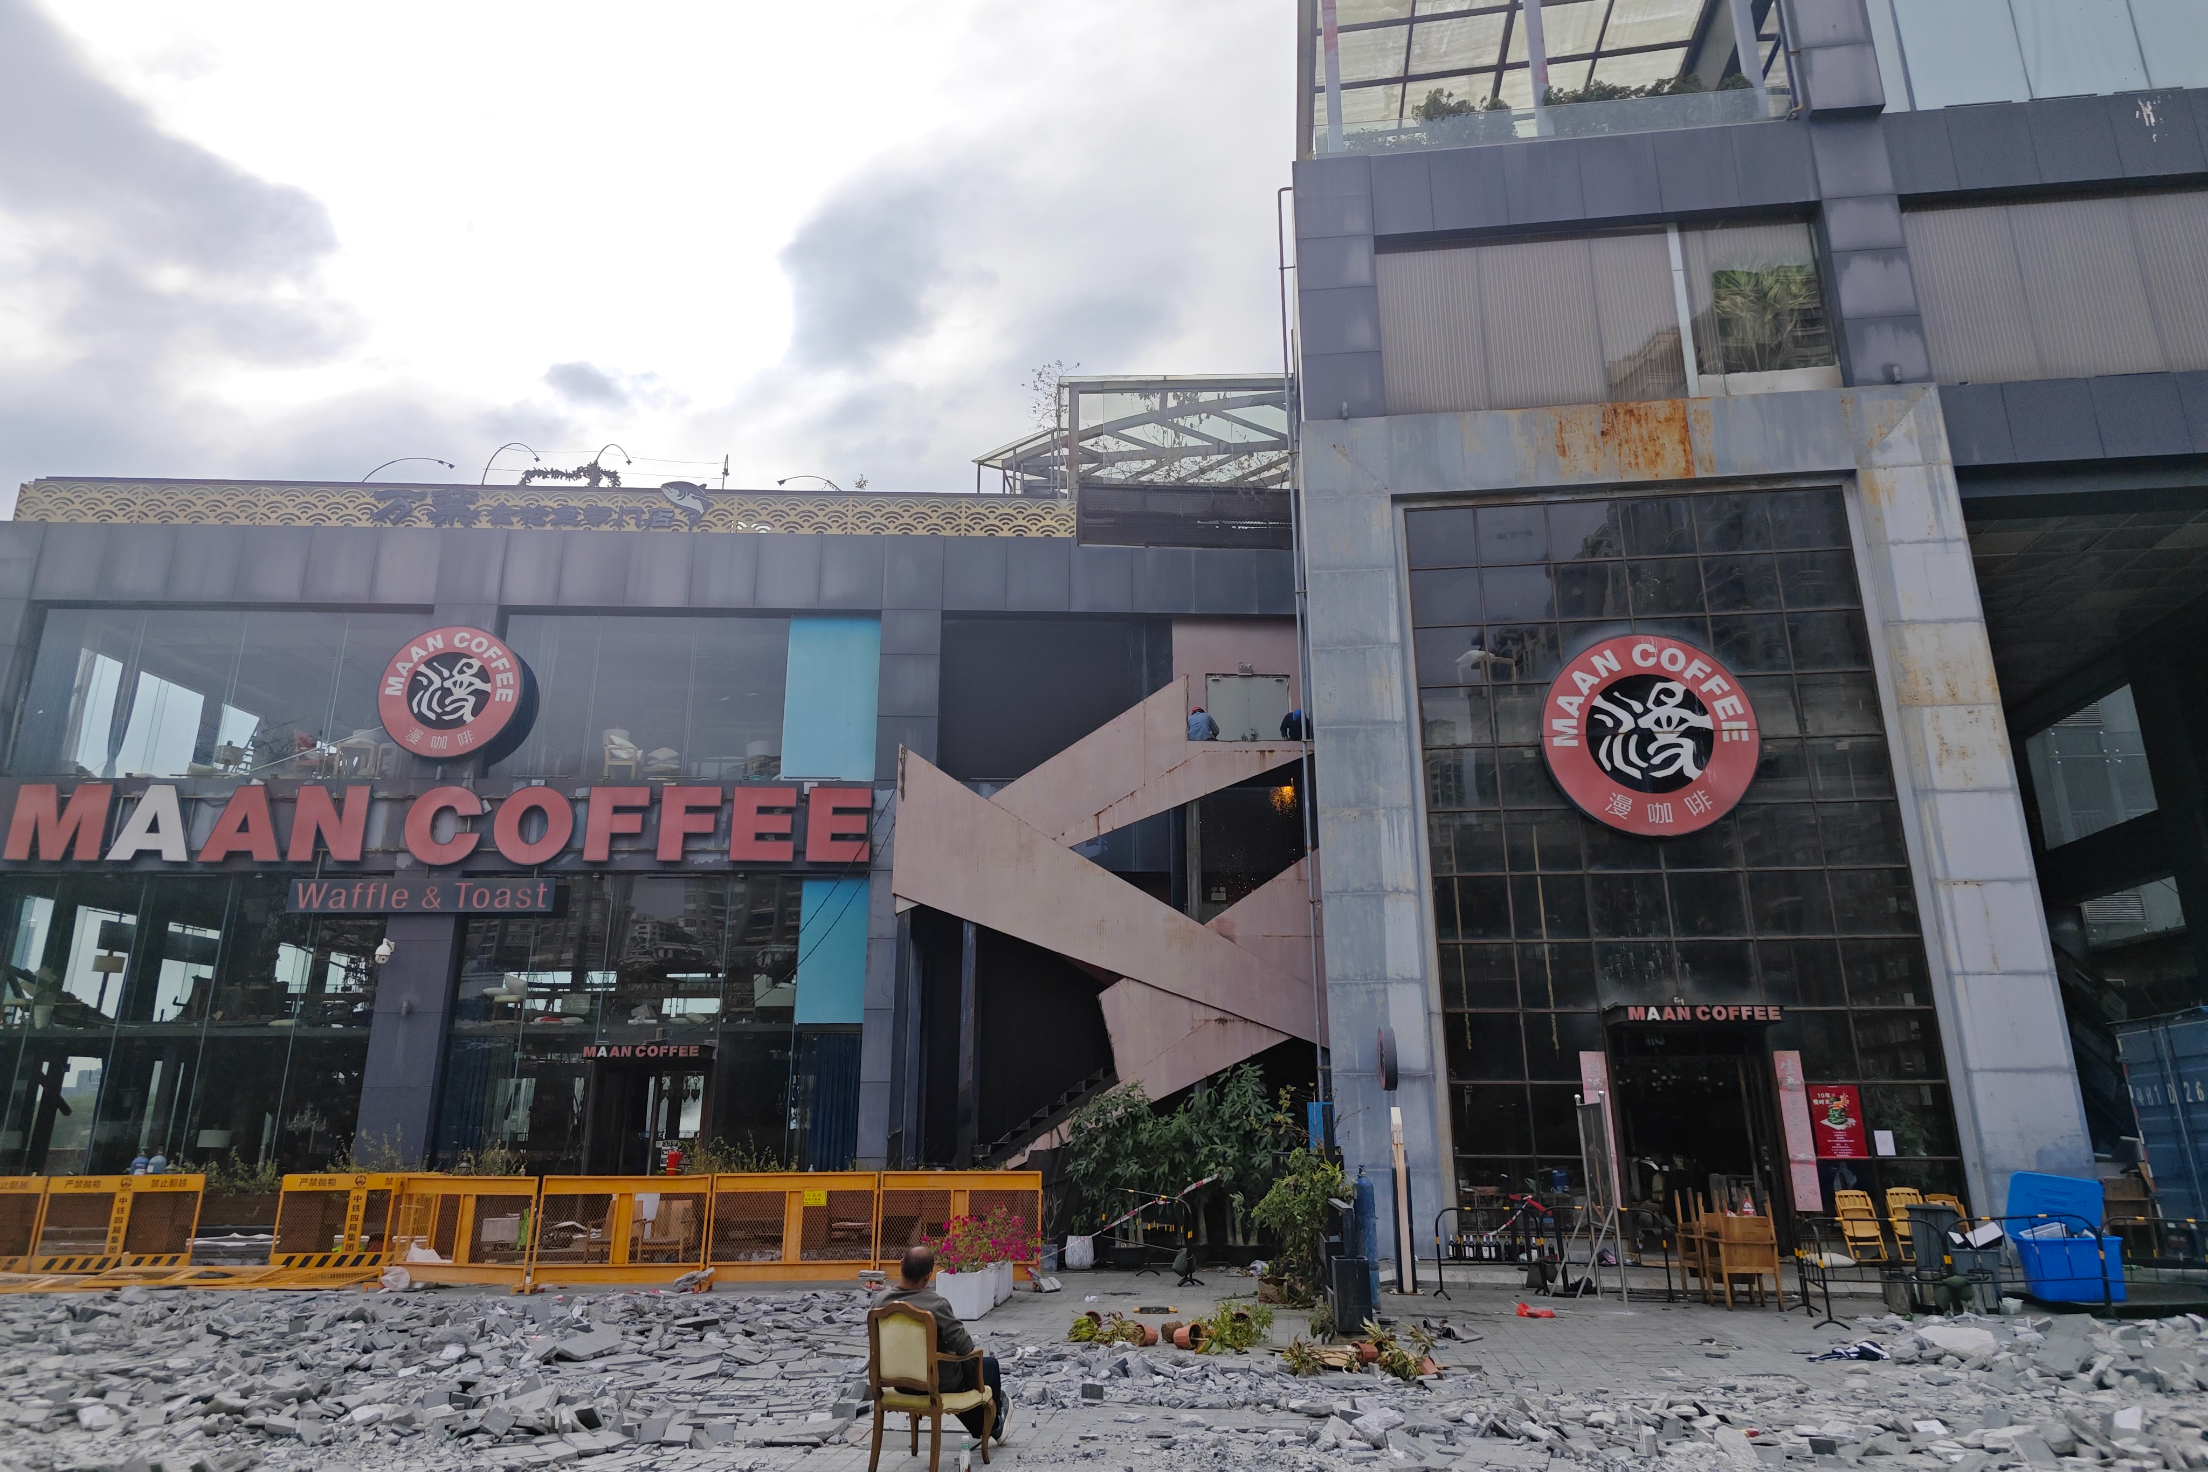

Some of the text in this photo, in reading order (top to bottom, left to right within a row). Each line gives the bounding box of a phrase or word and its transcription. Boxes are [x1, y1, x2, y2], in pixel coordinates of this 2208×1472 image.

[385, 632, 514, 703] MAAN COFFEE
[1552, 643, 1750, 747] MAAN COFFEE
[3, 784, 872, 866] MAAN COFFEE
[298, 882, 548, 910] Waffle & Toast
[1627, 1005, 1782, 1021] MAAN COFFEE
[583, 1045, 699, 1058] MAAN COFFEE
[108, 1197, 128, 1254] 中铁四局集团
[345, 1194, 363, 1252] 中铁四局集团
